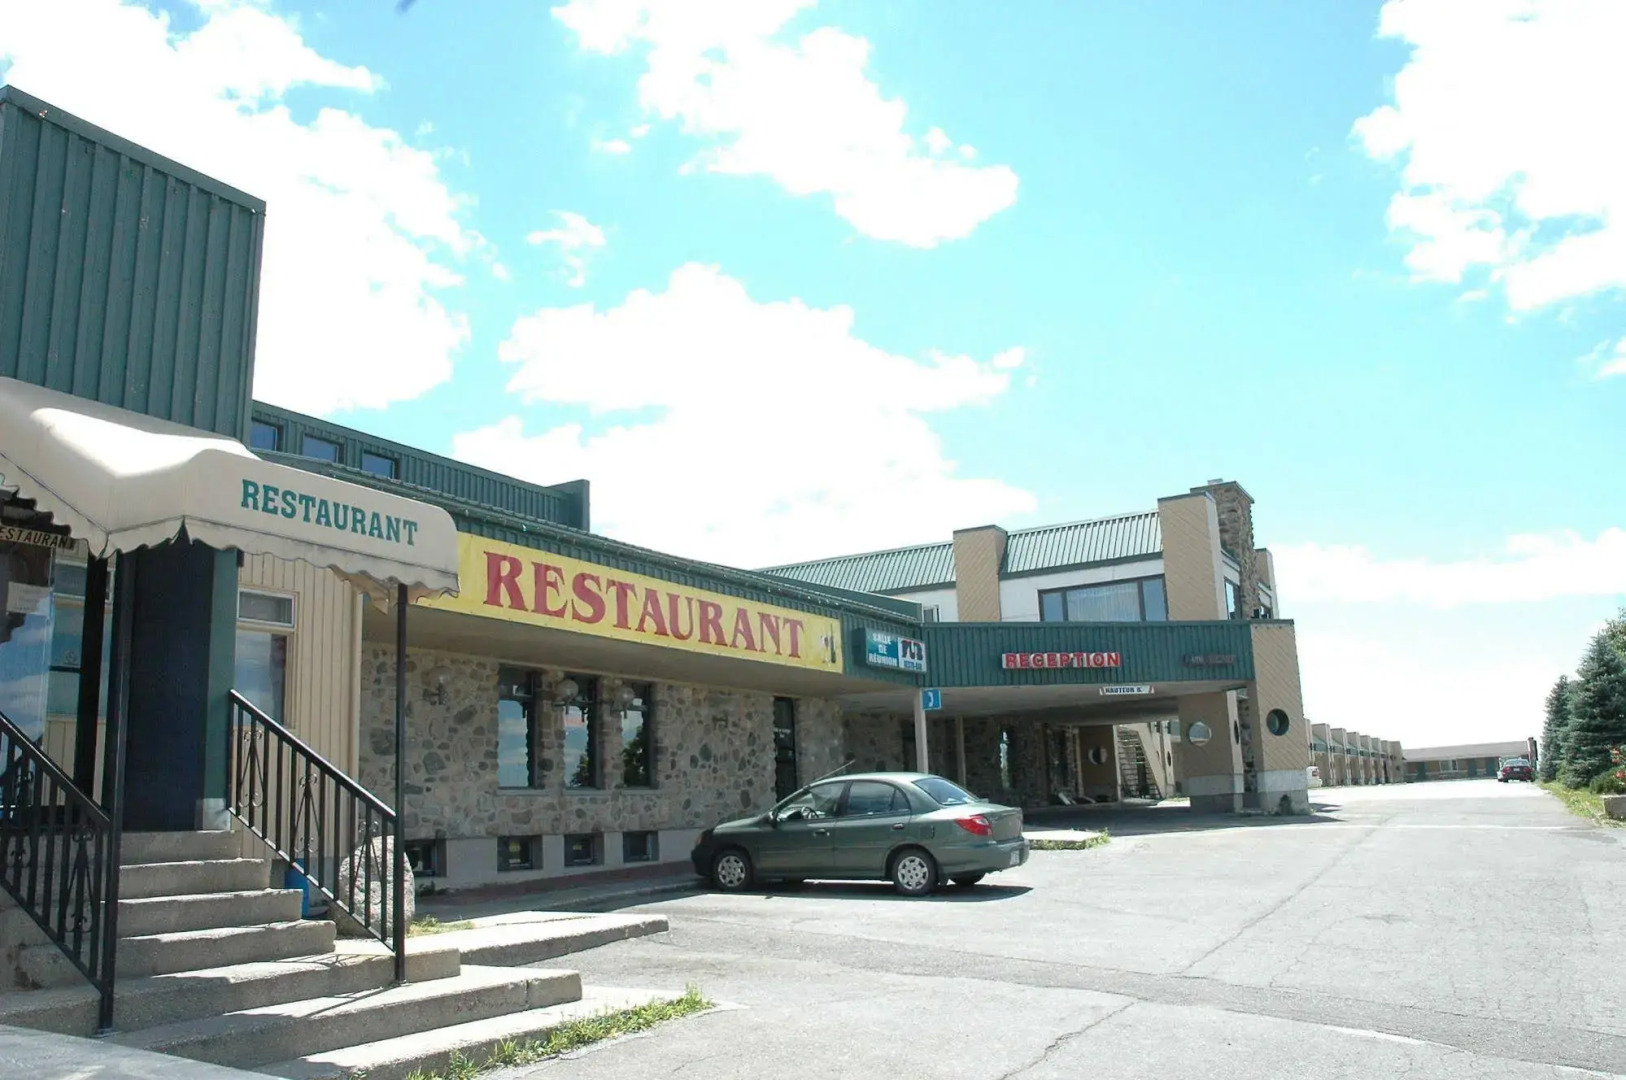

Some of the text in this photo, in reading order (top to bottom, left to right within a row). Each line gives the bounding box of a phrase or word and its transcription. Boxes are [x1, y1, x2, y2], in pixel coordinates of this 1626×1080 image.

[241, 479, 418, 546] RESTAURANT
[483, 551, 804, 658] RESTAURANT
[878, 644, 888, 655] DE
[1003, 652, 1121, 668] RECEPTION
